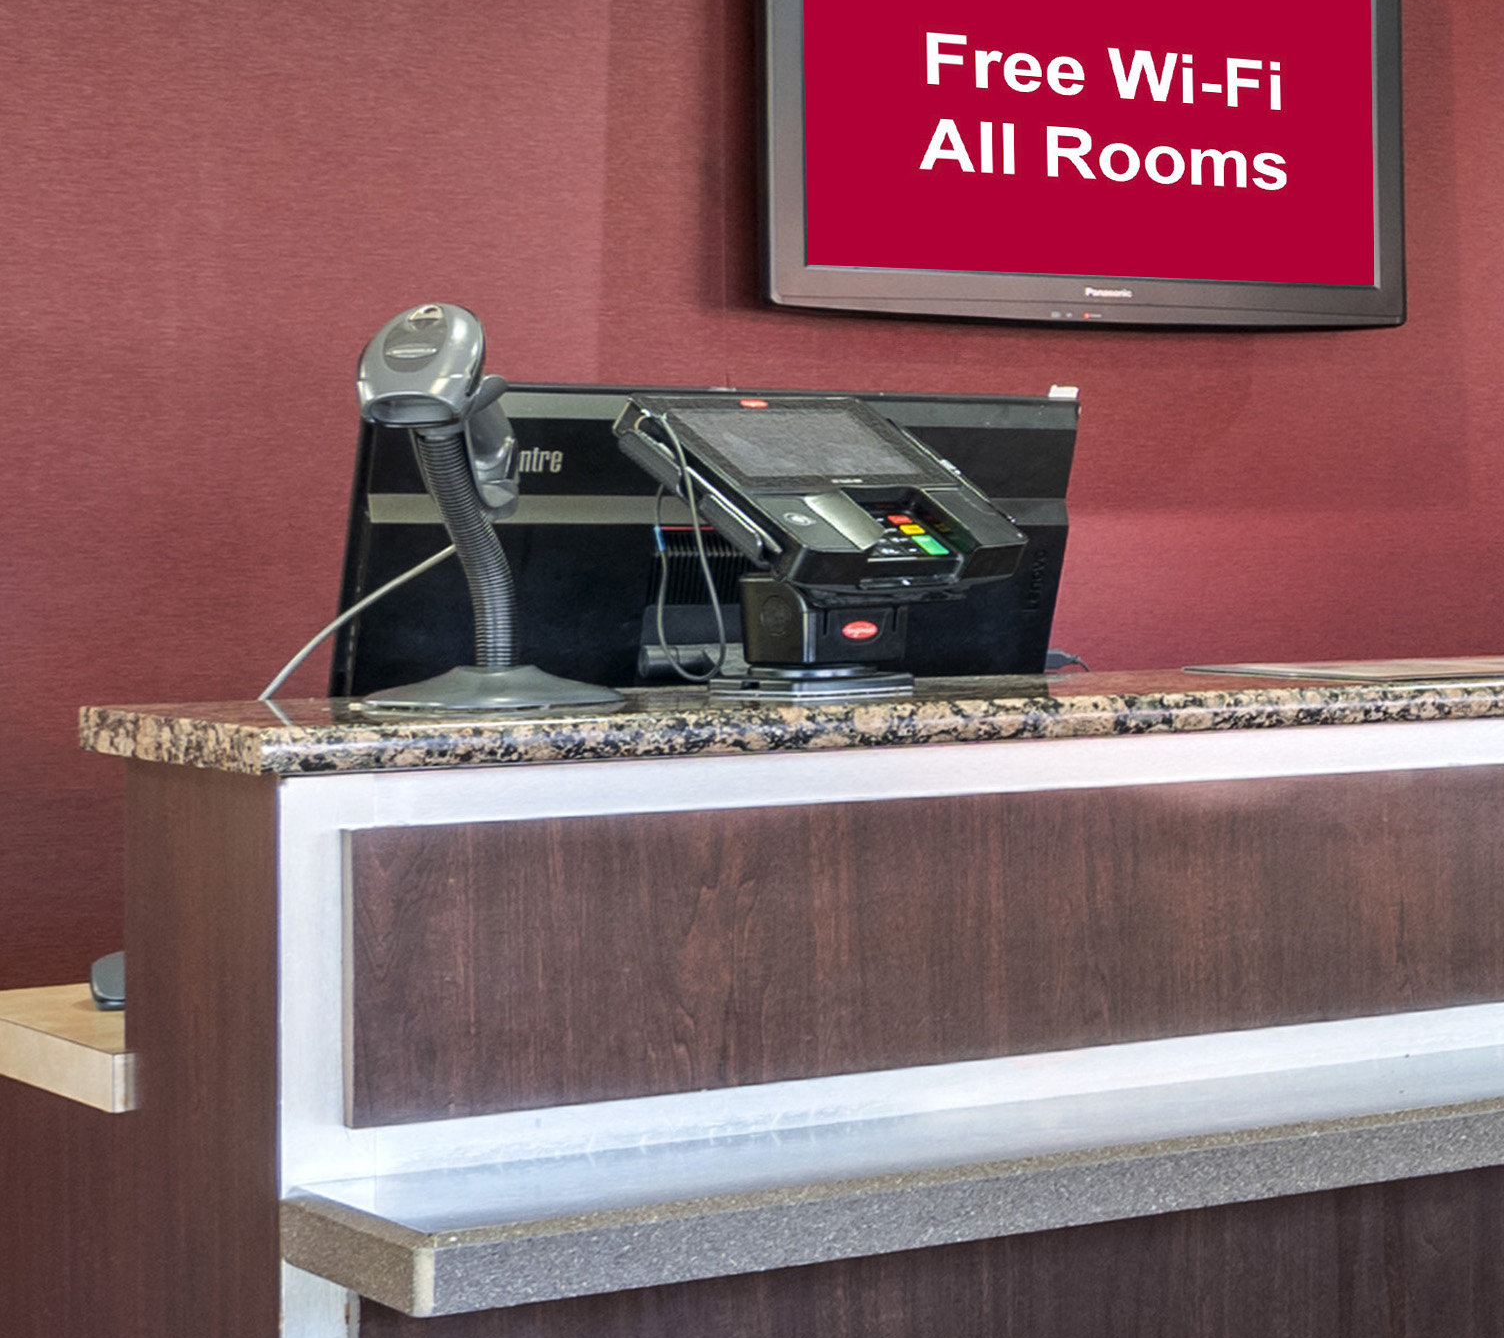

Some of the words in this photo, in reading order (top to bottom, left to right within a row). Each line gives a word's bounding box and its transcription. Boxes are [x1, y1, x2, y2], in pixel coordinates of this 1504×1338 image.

[925, 31, 1084, 96] Free
[1108, 46, 1282, 110] Wi-Fi
[919, 118, 1015, 175] All
[1046, 125, 1288, 191] Rooms
